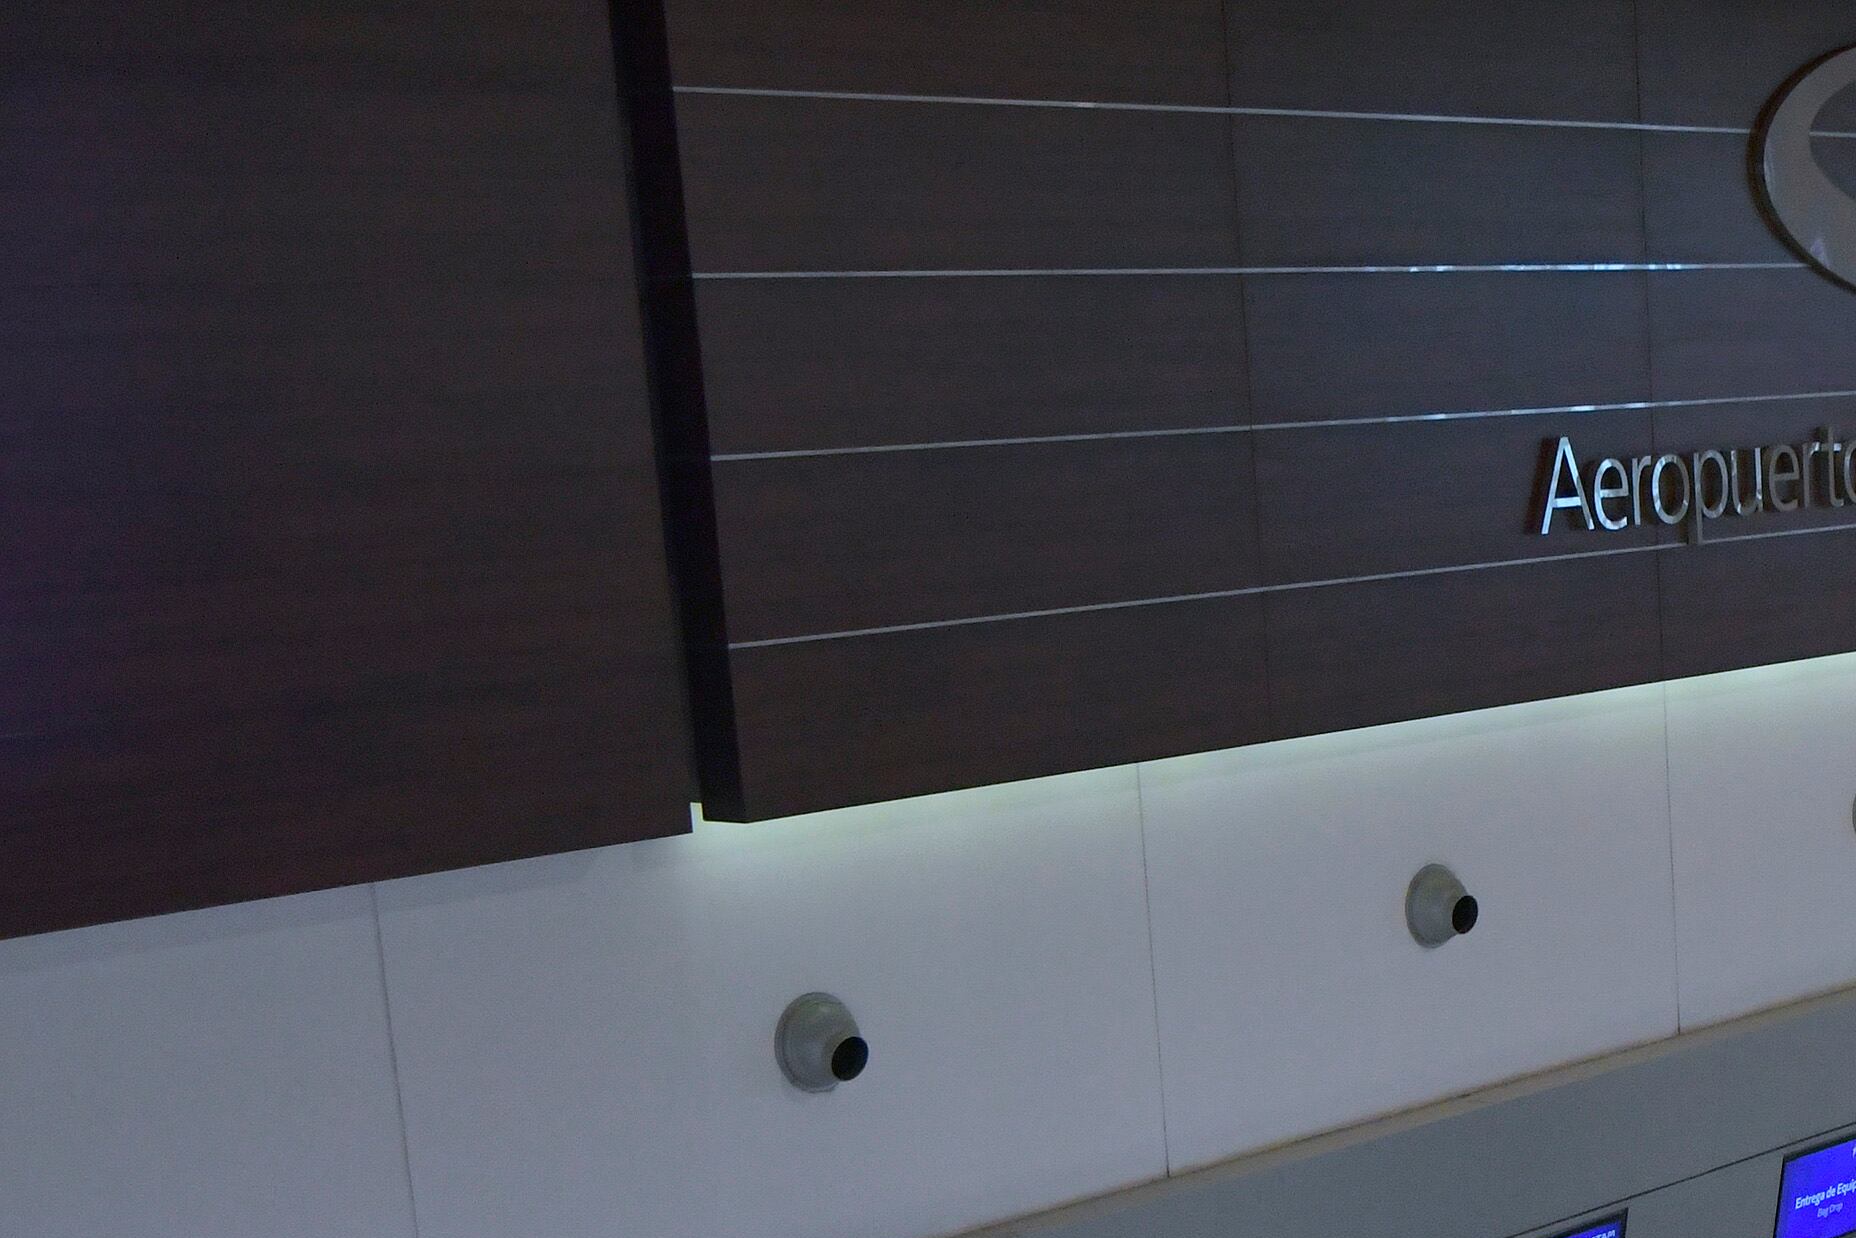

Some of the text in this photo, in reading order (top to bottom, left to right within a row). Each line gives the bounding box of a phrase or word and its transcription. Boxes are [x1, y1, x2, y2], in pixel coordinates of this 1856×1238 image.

[1795, 1190, 1825, 1210] Entrega
[1825, 1185, 1836, 1199] de
[1817, 1201, 1844, 1218] Bag Drop
